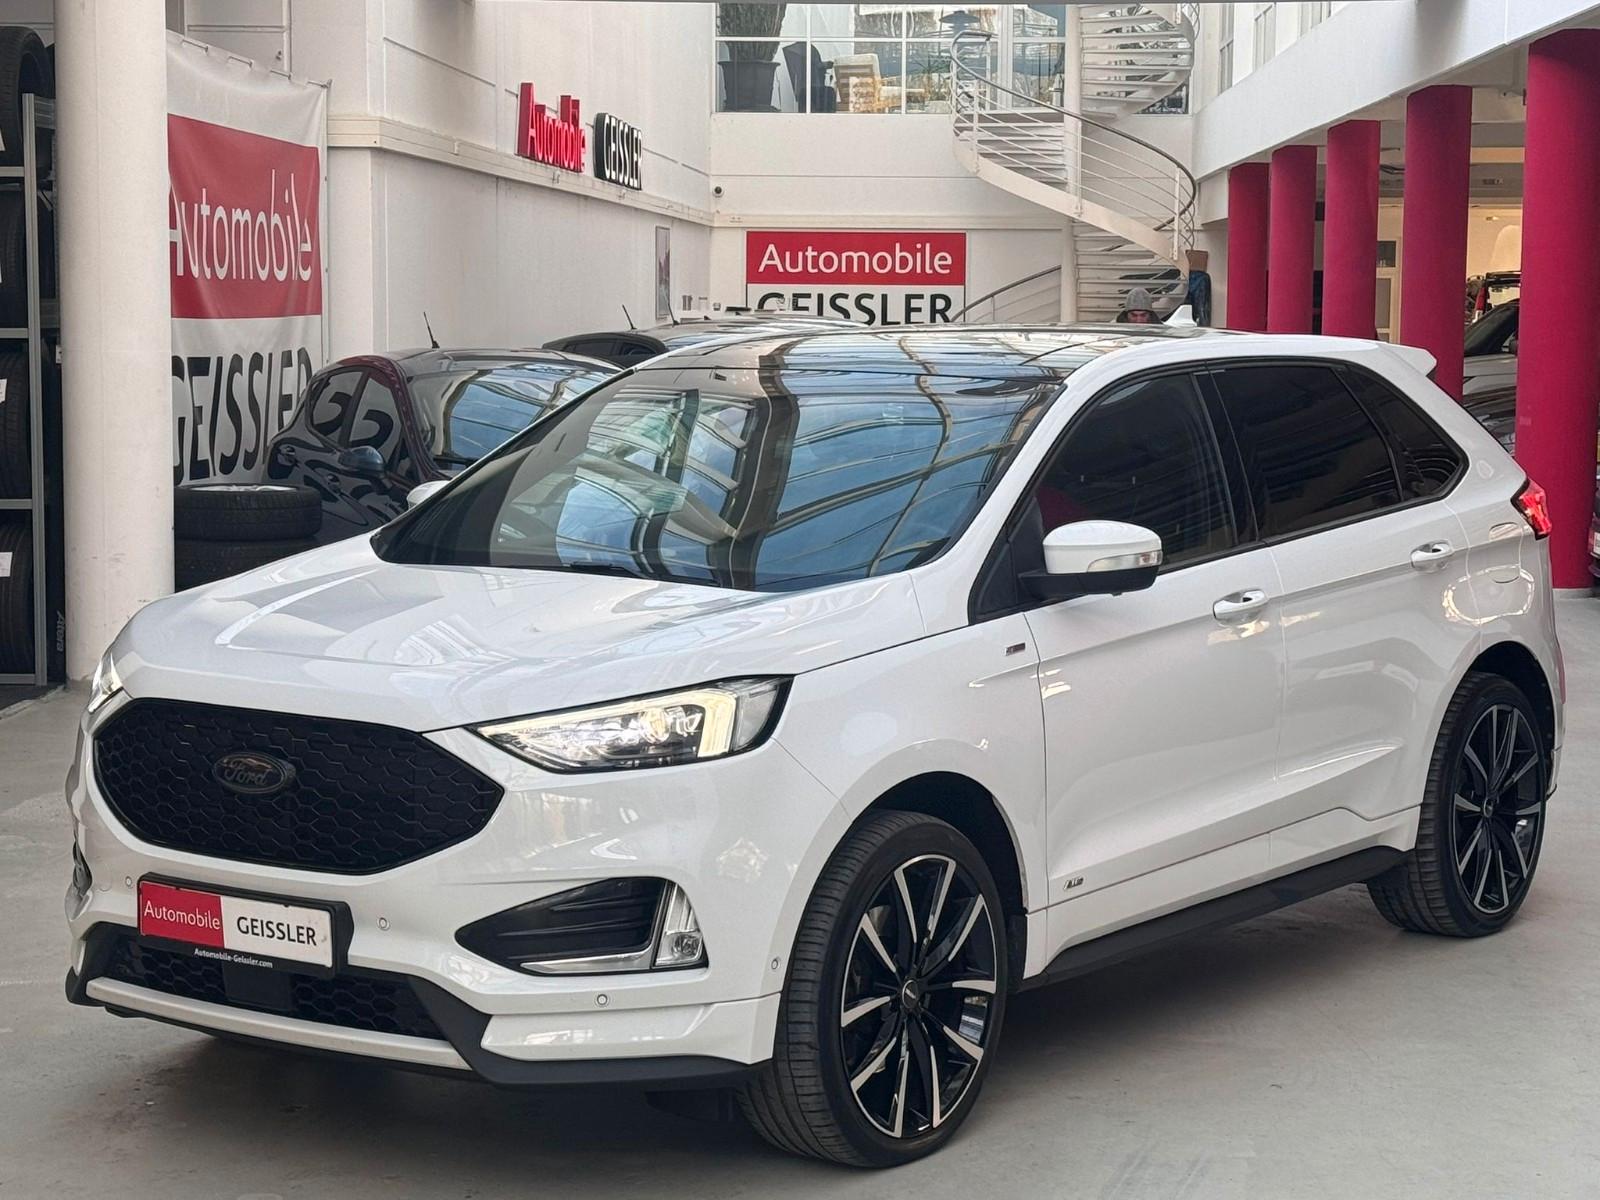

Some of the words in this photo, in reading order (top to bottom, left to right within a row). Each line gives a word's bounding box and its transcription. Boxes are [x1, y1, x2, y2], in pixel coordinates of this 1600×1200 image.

[519, 83, 587, 173] Automobile
[598, 112, 643, 190] GEISSLER
[168, 169, 312, 282] Automobile
[758, 242, 953, 275] Automobile
[221, 757, 273, 786] Ford
[143, 900, 221, 930] Automobile
[236, 916, 318, 946] GEISSLER
[194, 948, 274, 969] Automobile-Geissler.com
